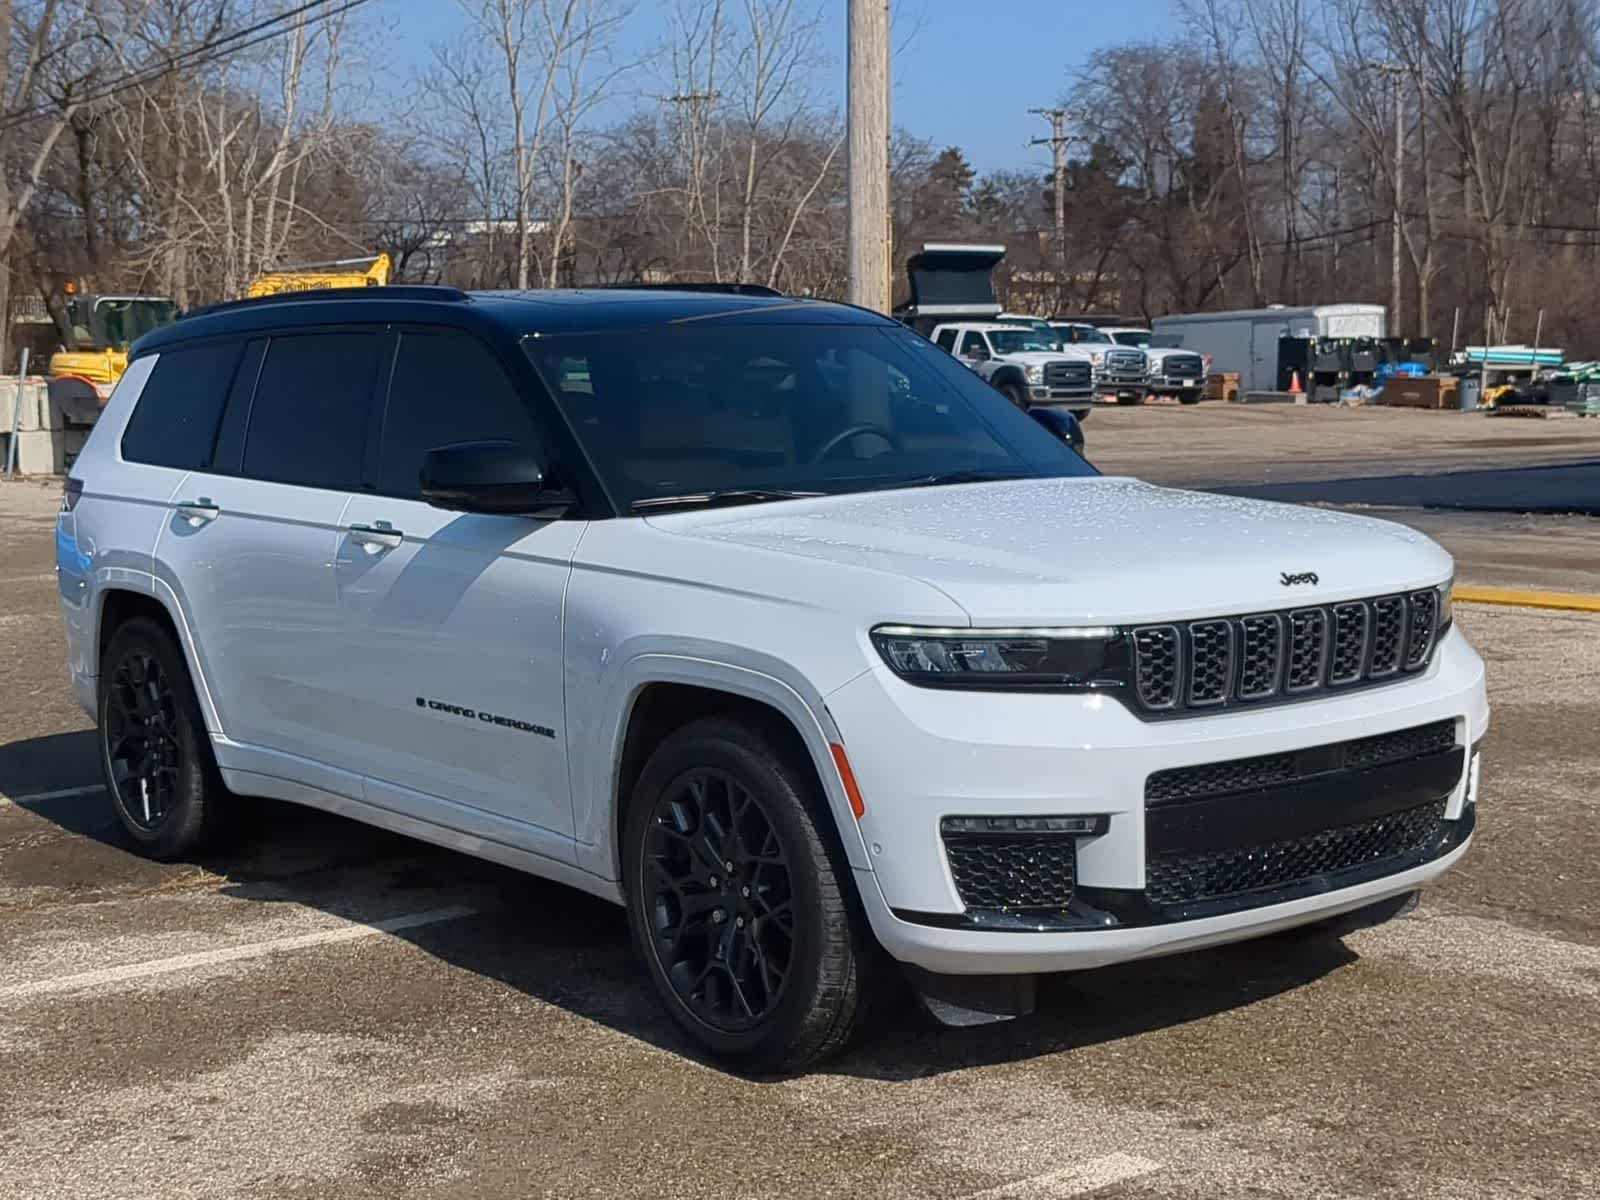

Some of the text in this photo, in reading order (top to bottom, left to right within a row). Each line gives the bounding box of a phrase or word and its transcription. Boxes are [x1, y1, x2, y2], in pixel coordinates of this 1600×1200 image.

[1280, 571, 1319, 586] Jeep
[428, 700, 556, 739] GRAND CHEROKEE
